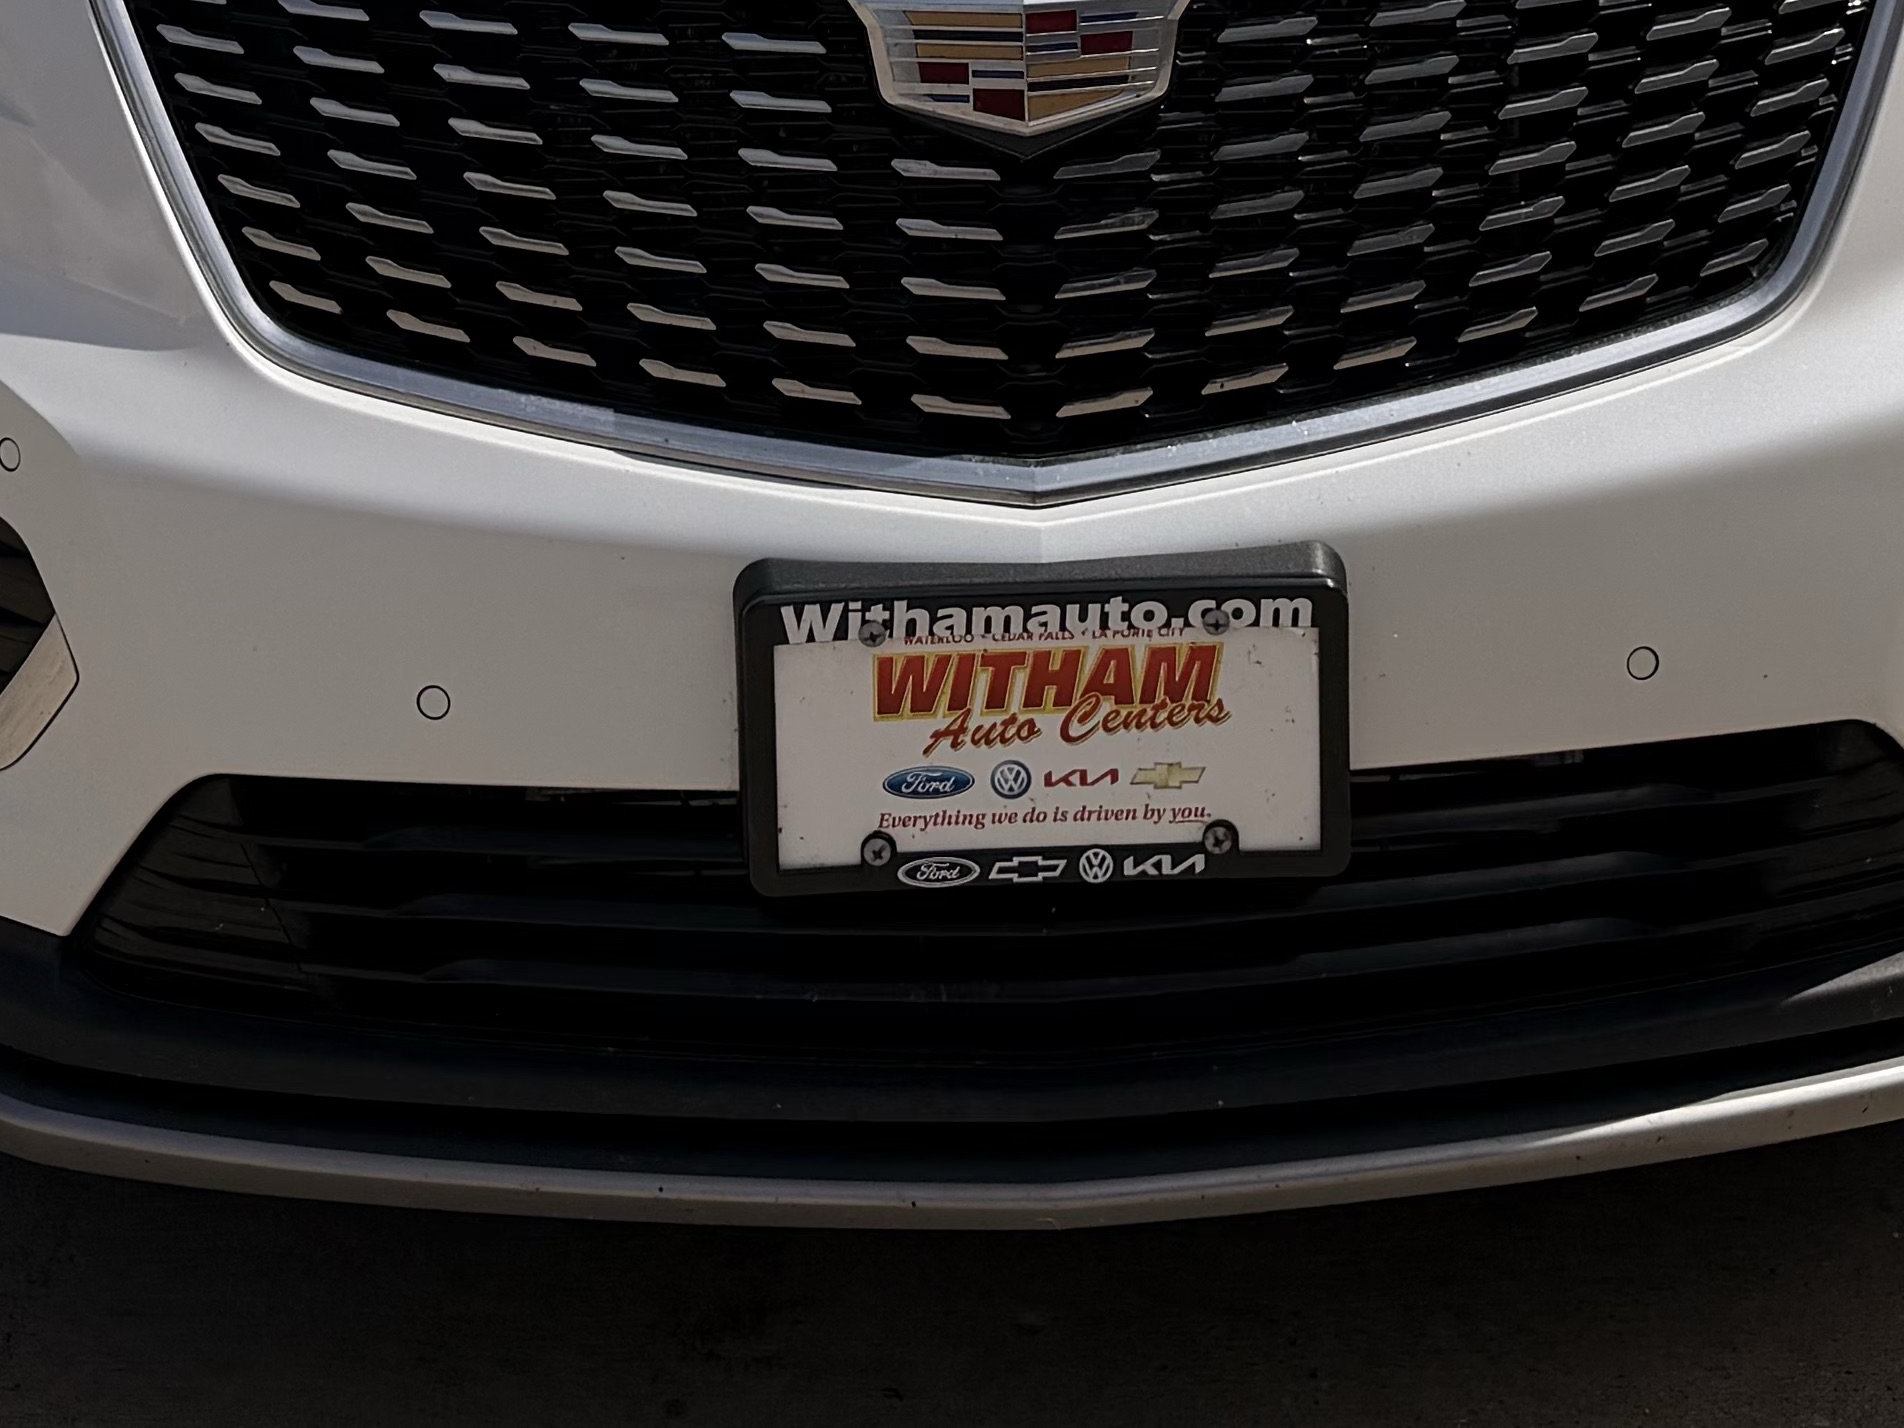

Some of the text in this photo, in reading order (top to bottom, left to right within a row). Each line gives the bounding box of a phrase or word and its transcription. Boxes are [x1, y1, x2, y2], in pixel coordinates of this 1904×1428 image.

[780, 596, 1313, 644] Withamauto.com
[874, 643, 1223, 721] WITHAM
[921, 691, 1232, 758] Auto Centers
[878, 803, 1212, 831] Everything we do is driven by you.
